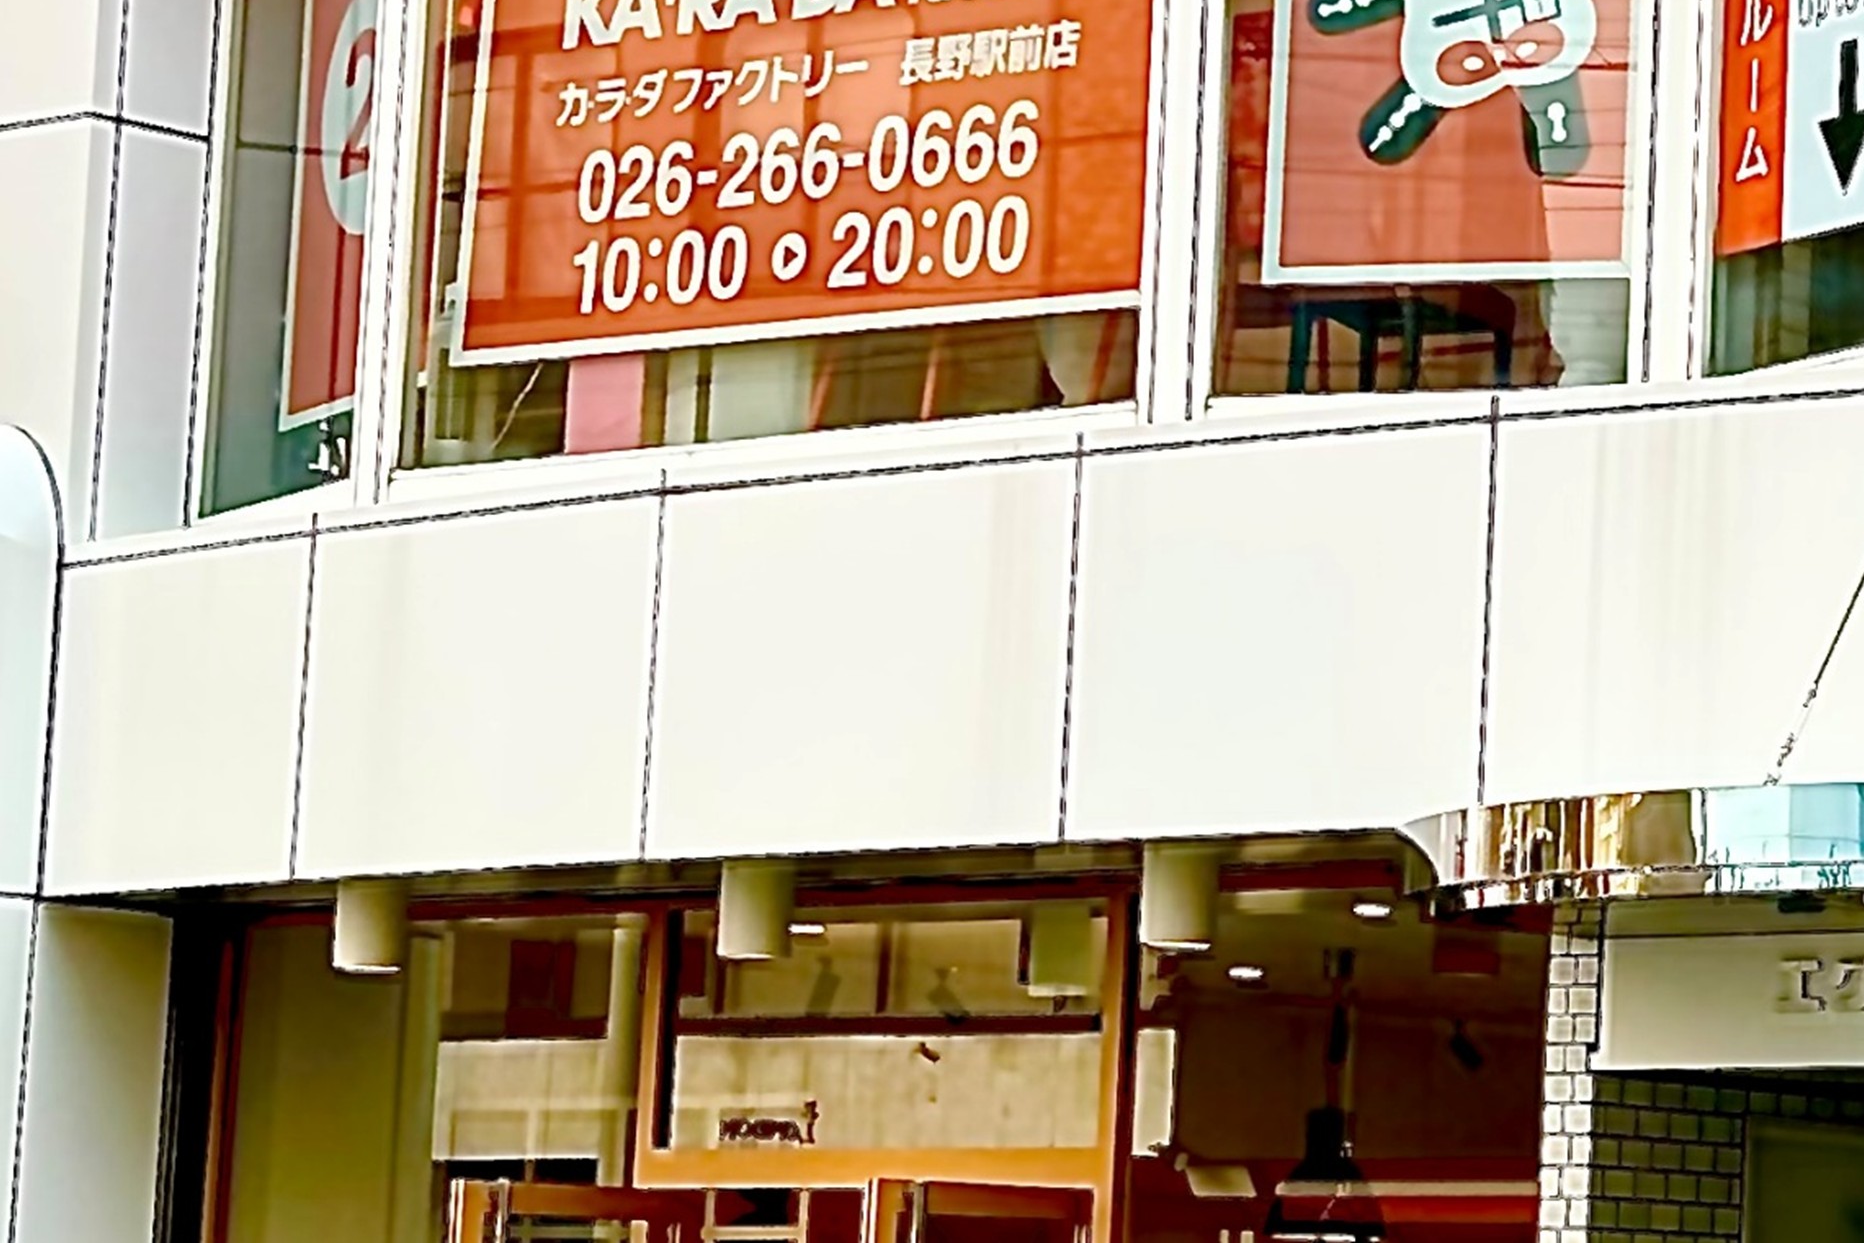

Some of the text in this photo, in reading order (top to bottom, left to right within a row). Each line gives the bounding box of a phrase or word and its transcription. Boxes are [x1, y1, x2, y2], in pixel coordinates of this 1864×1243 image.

[899, 19, 1082, 87] 長野駅前店
[576, 99, 1041, 225] 026-266-0666
[573, 194, 1031, 315] 10:00 20:00
